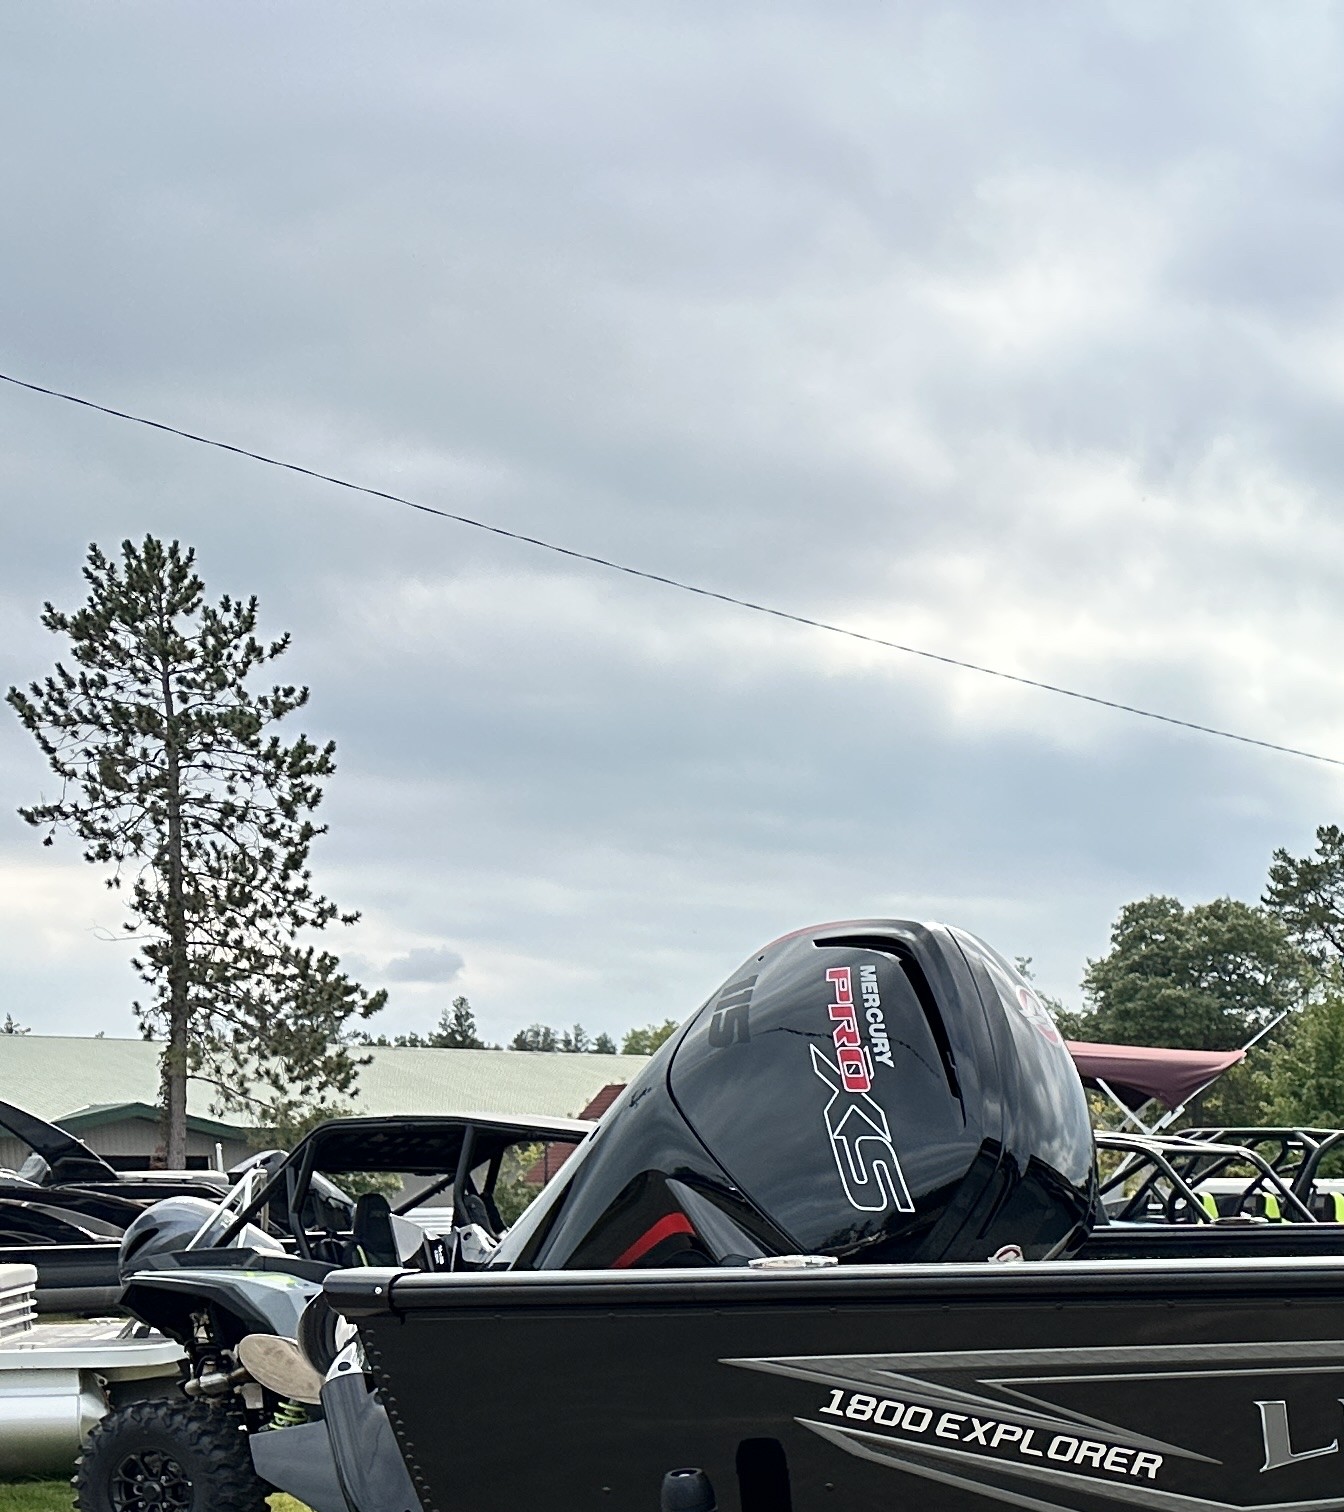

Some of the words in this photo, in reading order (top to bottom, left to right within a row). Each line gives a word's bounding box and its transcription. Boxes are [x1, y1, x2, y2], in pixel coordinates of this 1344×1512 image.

[708, 974, 759, 1048] 115
[825, 966, 872, 1093] PRO
[859, 964, 895, 1068] MERCURY
[809, 1042, 916, 1213] XS
[818, 1388, 933, 1434] 1800
[935, 1412, 1164, 1479] EXPLORER
